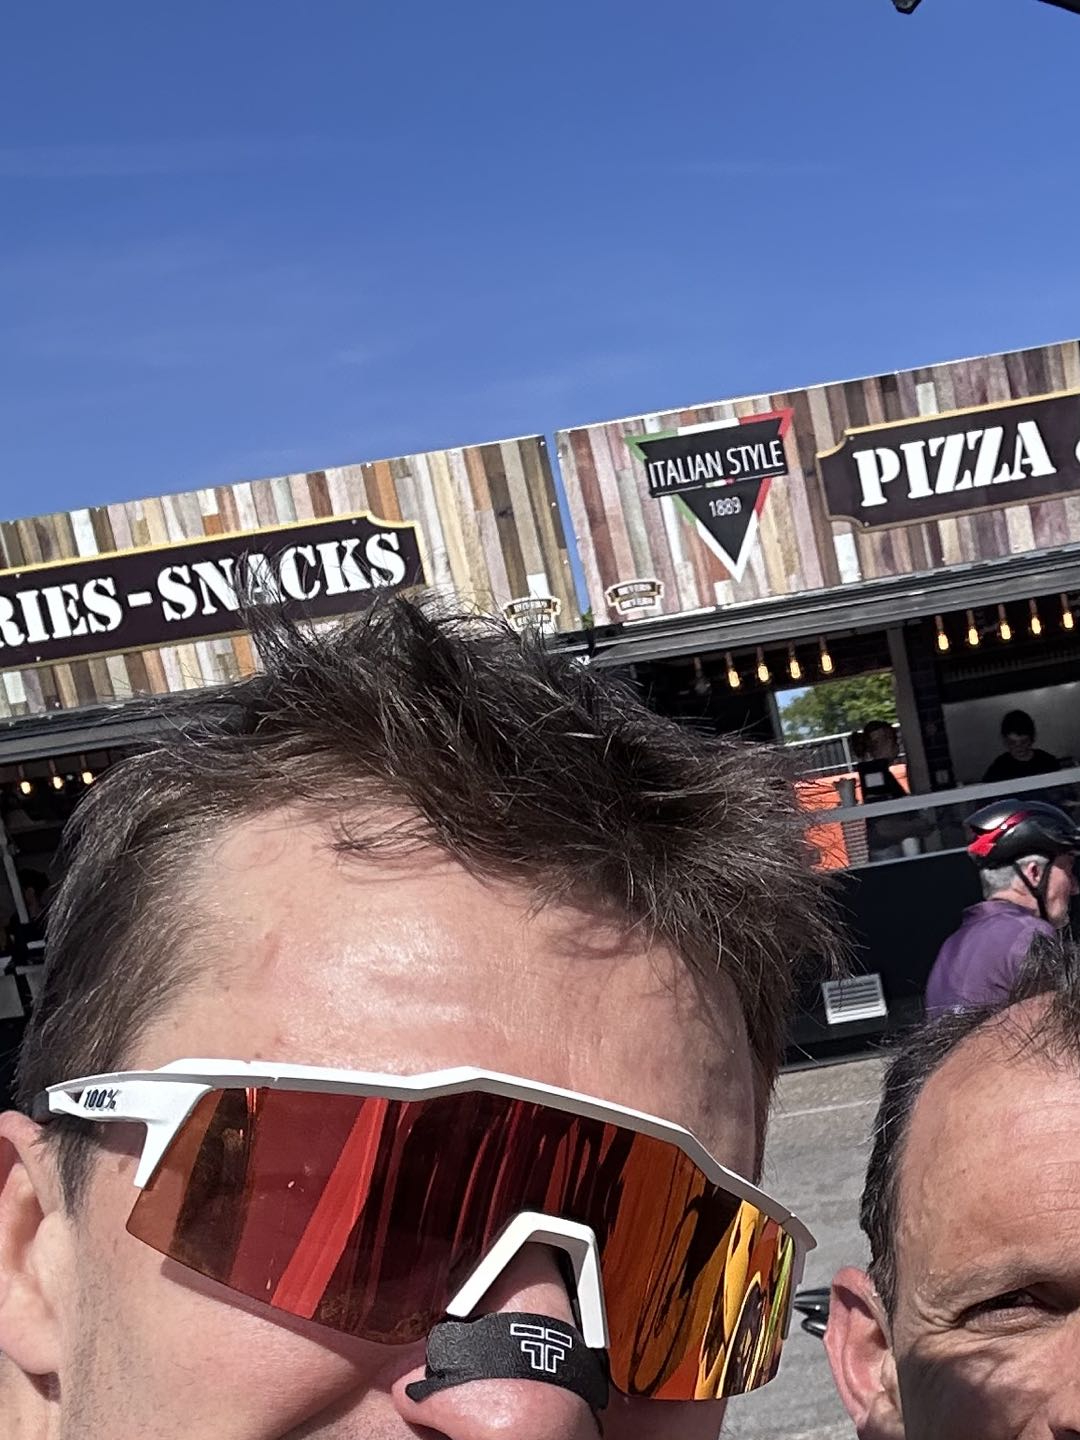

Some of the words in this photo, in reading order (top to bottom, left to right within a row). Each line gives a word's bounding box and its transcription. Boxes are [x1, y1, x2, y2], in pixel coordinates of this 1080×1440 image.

[648, 452, 725, 490] ITALIAN
[728, 440, 786, 477] STYLE
[851, 424, 1058, 510] PIZZA
[708, 496, 743, 518] 1889
[84, 1088, 120, 1110] 100%
